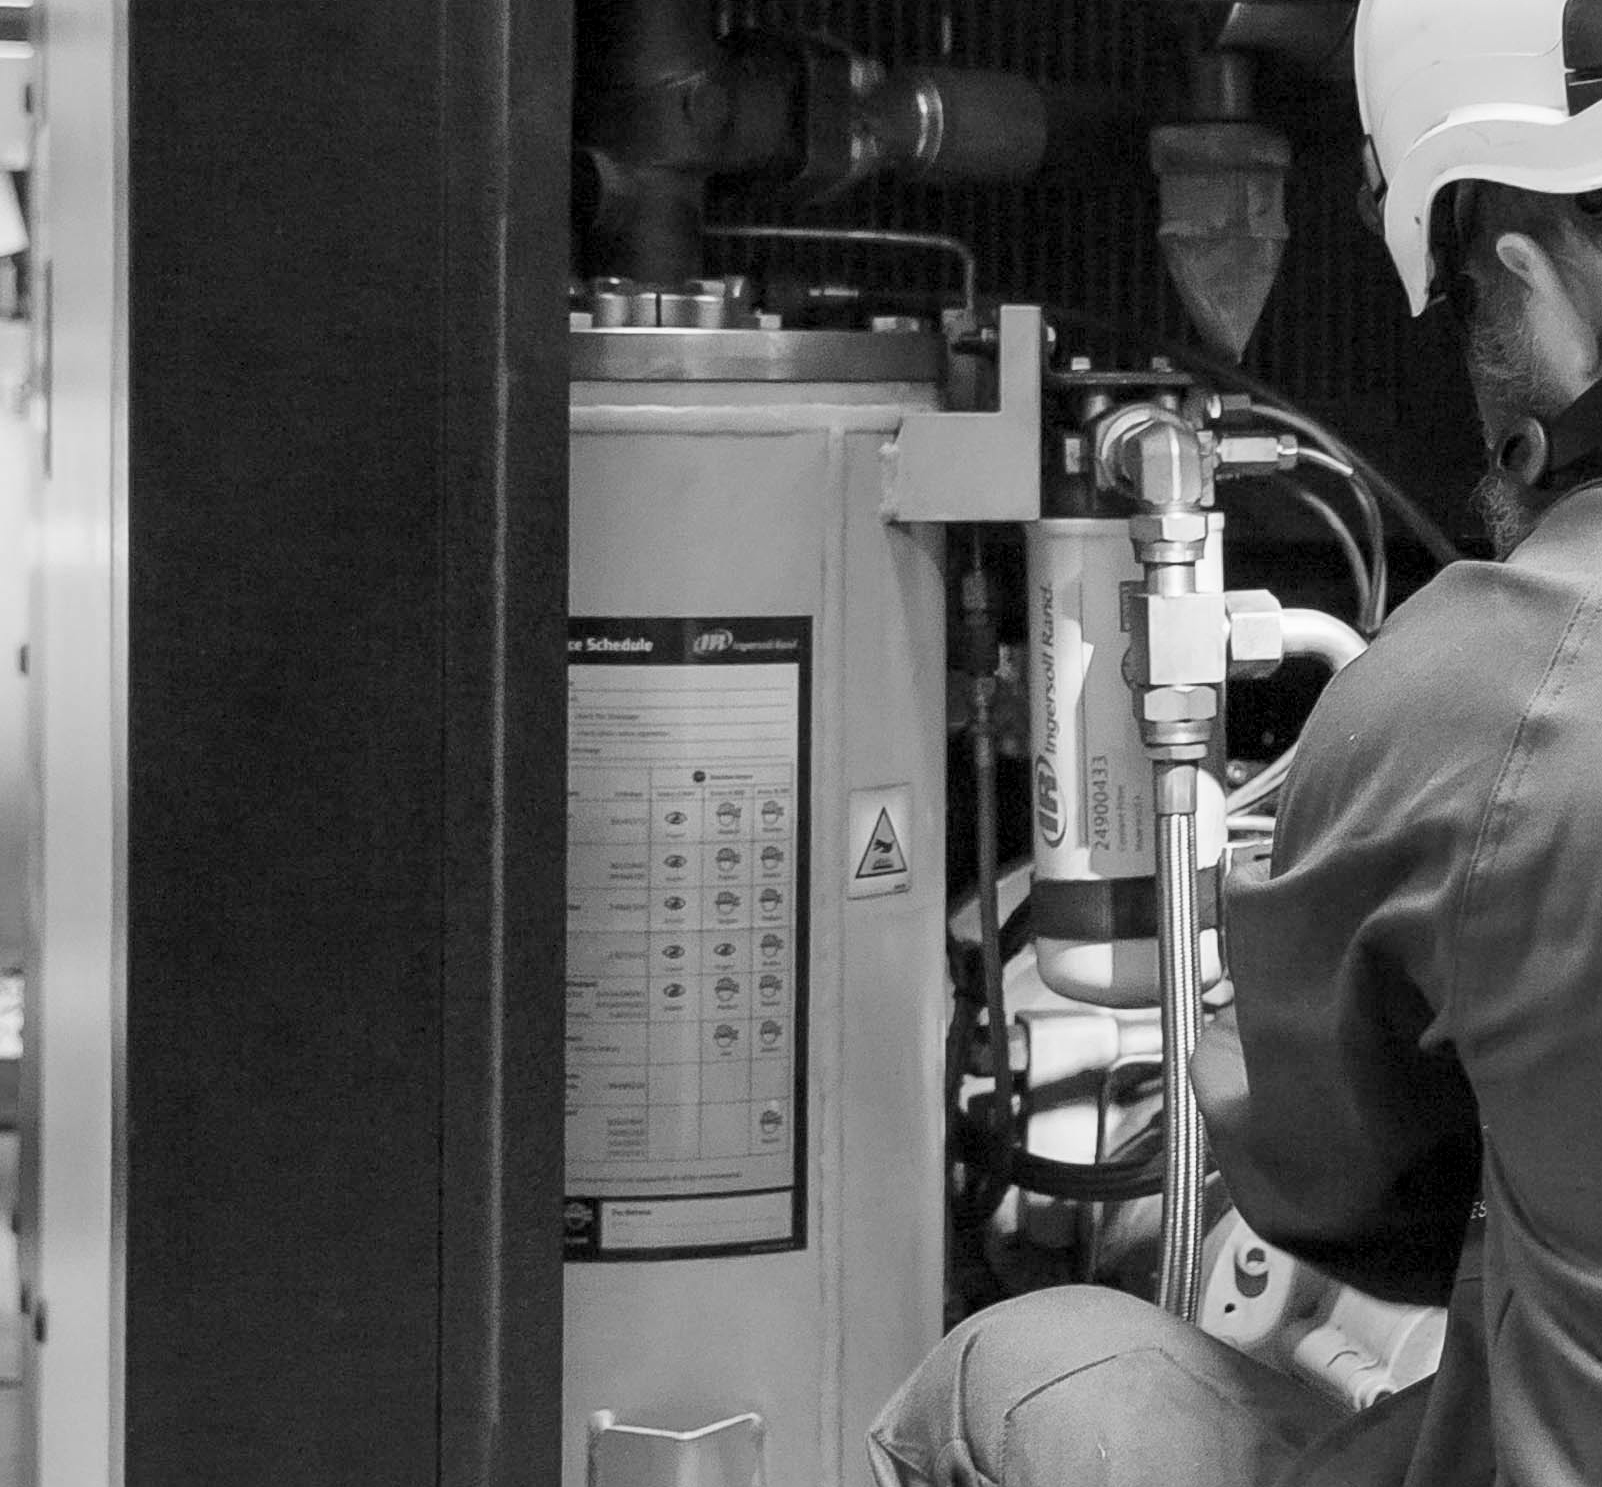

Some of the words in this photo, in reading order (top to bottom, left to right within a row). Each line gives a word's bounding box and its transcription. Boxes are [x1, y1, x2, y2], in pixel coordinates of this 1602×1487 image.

[586, 637, 654, 653] Schedule
[1040, 586, 1054, 647] Rand
[1042, 651, 1060, 755] Ingersoll
[1091, 755, 1110, 851] 24900433
